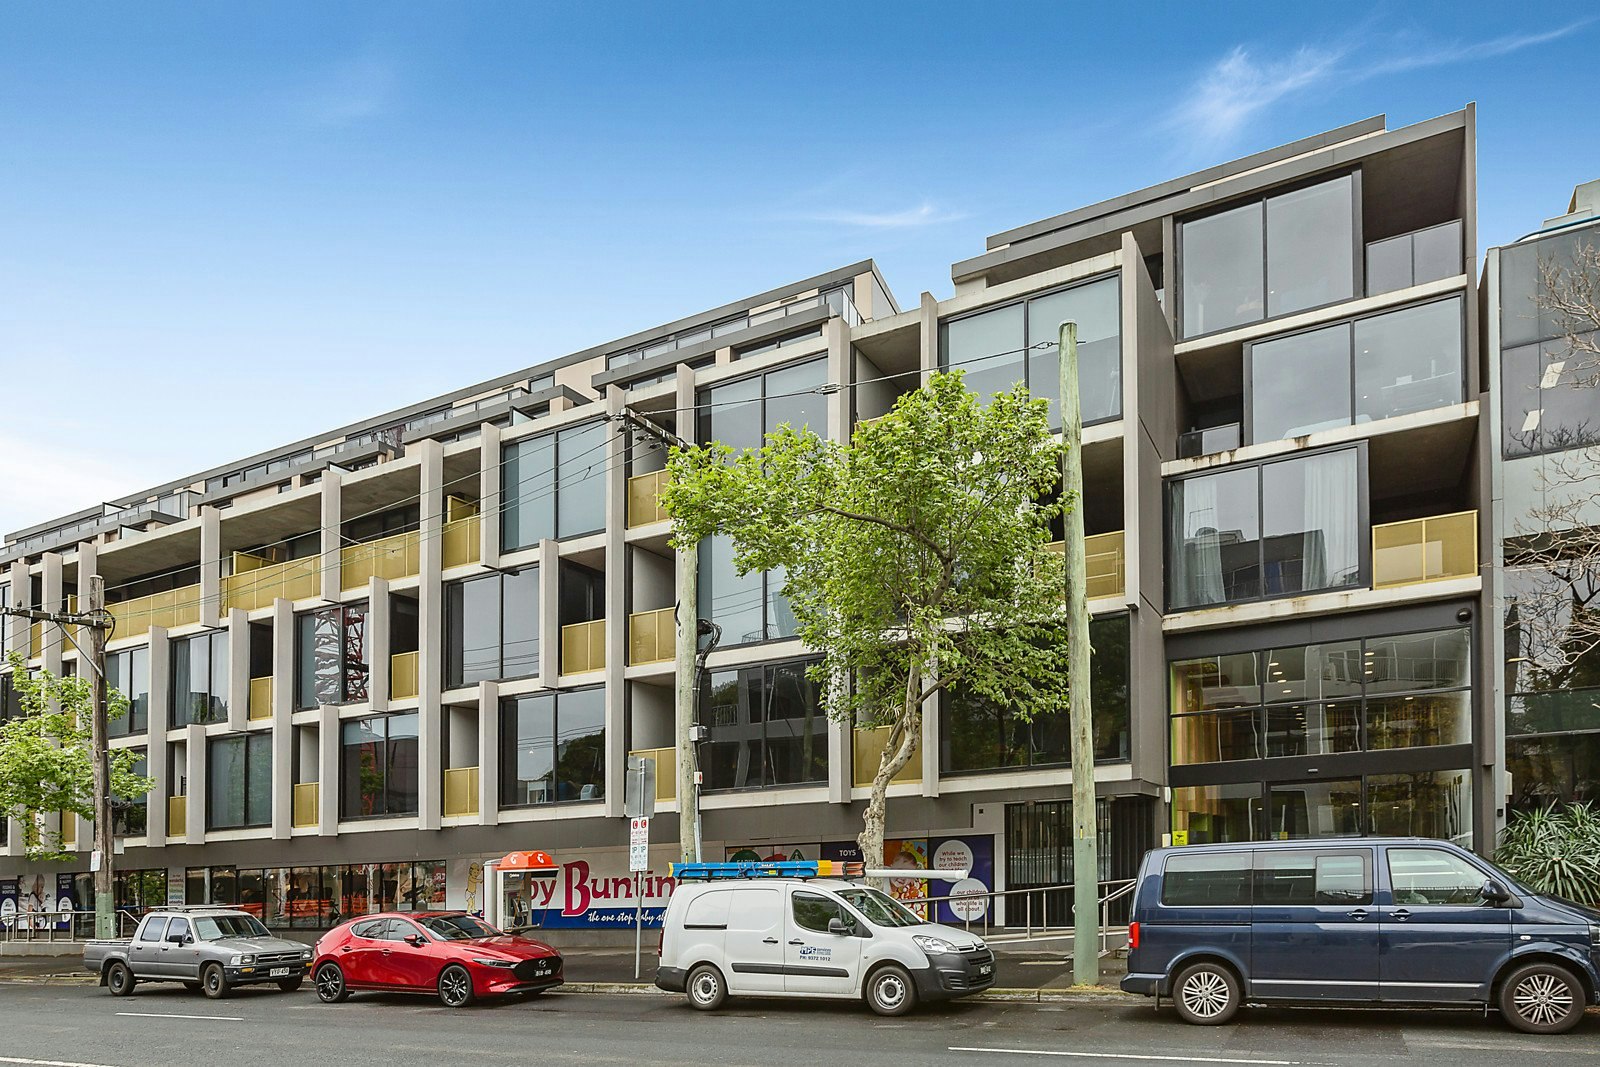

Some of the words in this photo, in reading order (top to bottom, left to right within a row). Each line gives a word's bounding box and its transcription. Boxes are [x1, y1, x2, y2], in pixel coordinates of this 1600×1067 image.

[839, 849, 857, 857] TOYS
[588, 911, 600, 922] the
[616, 912, 634, 925] stop
